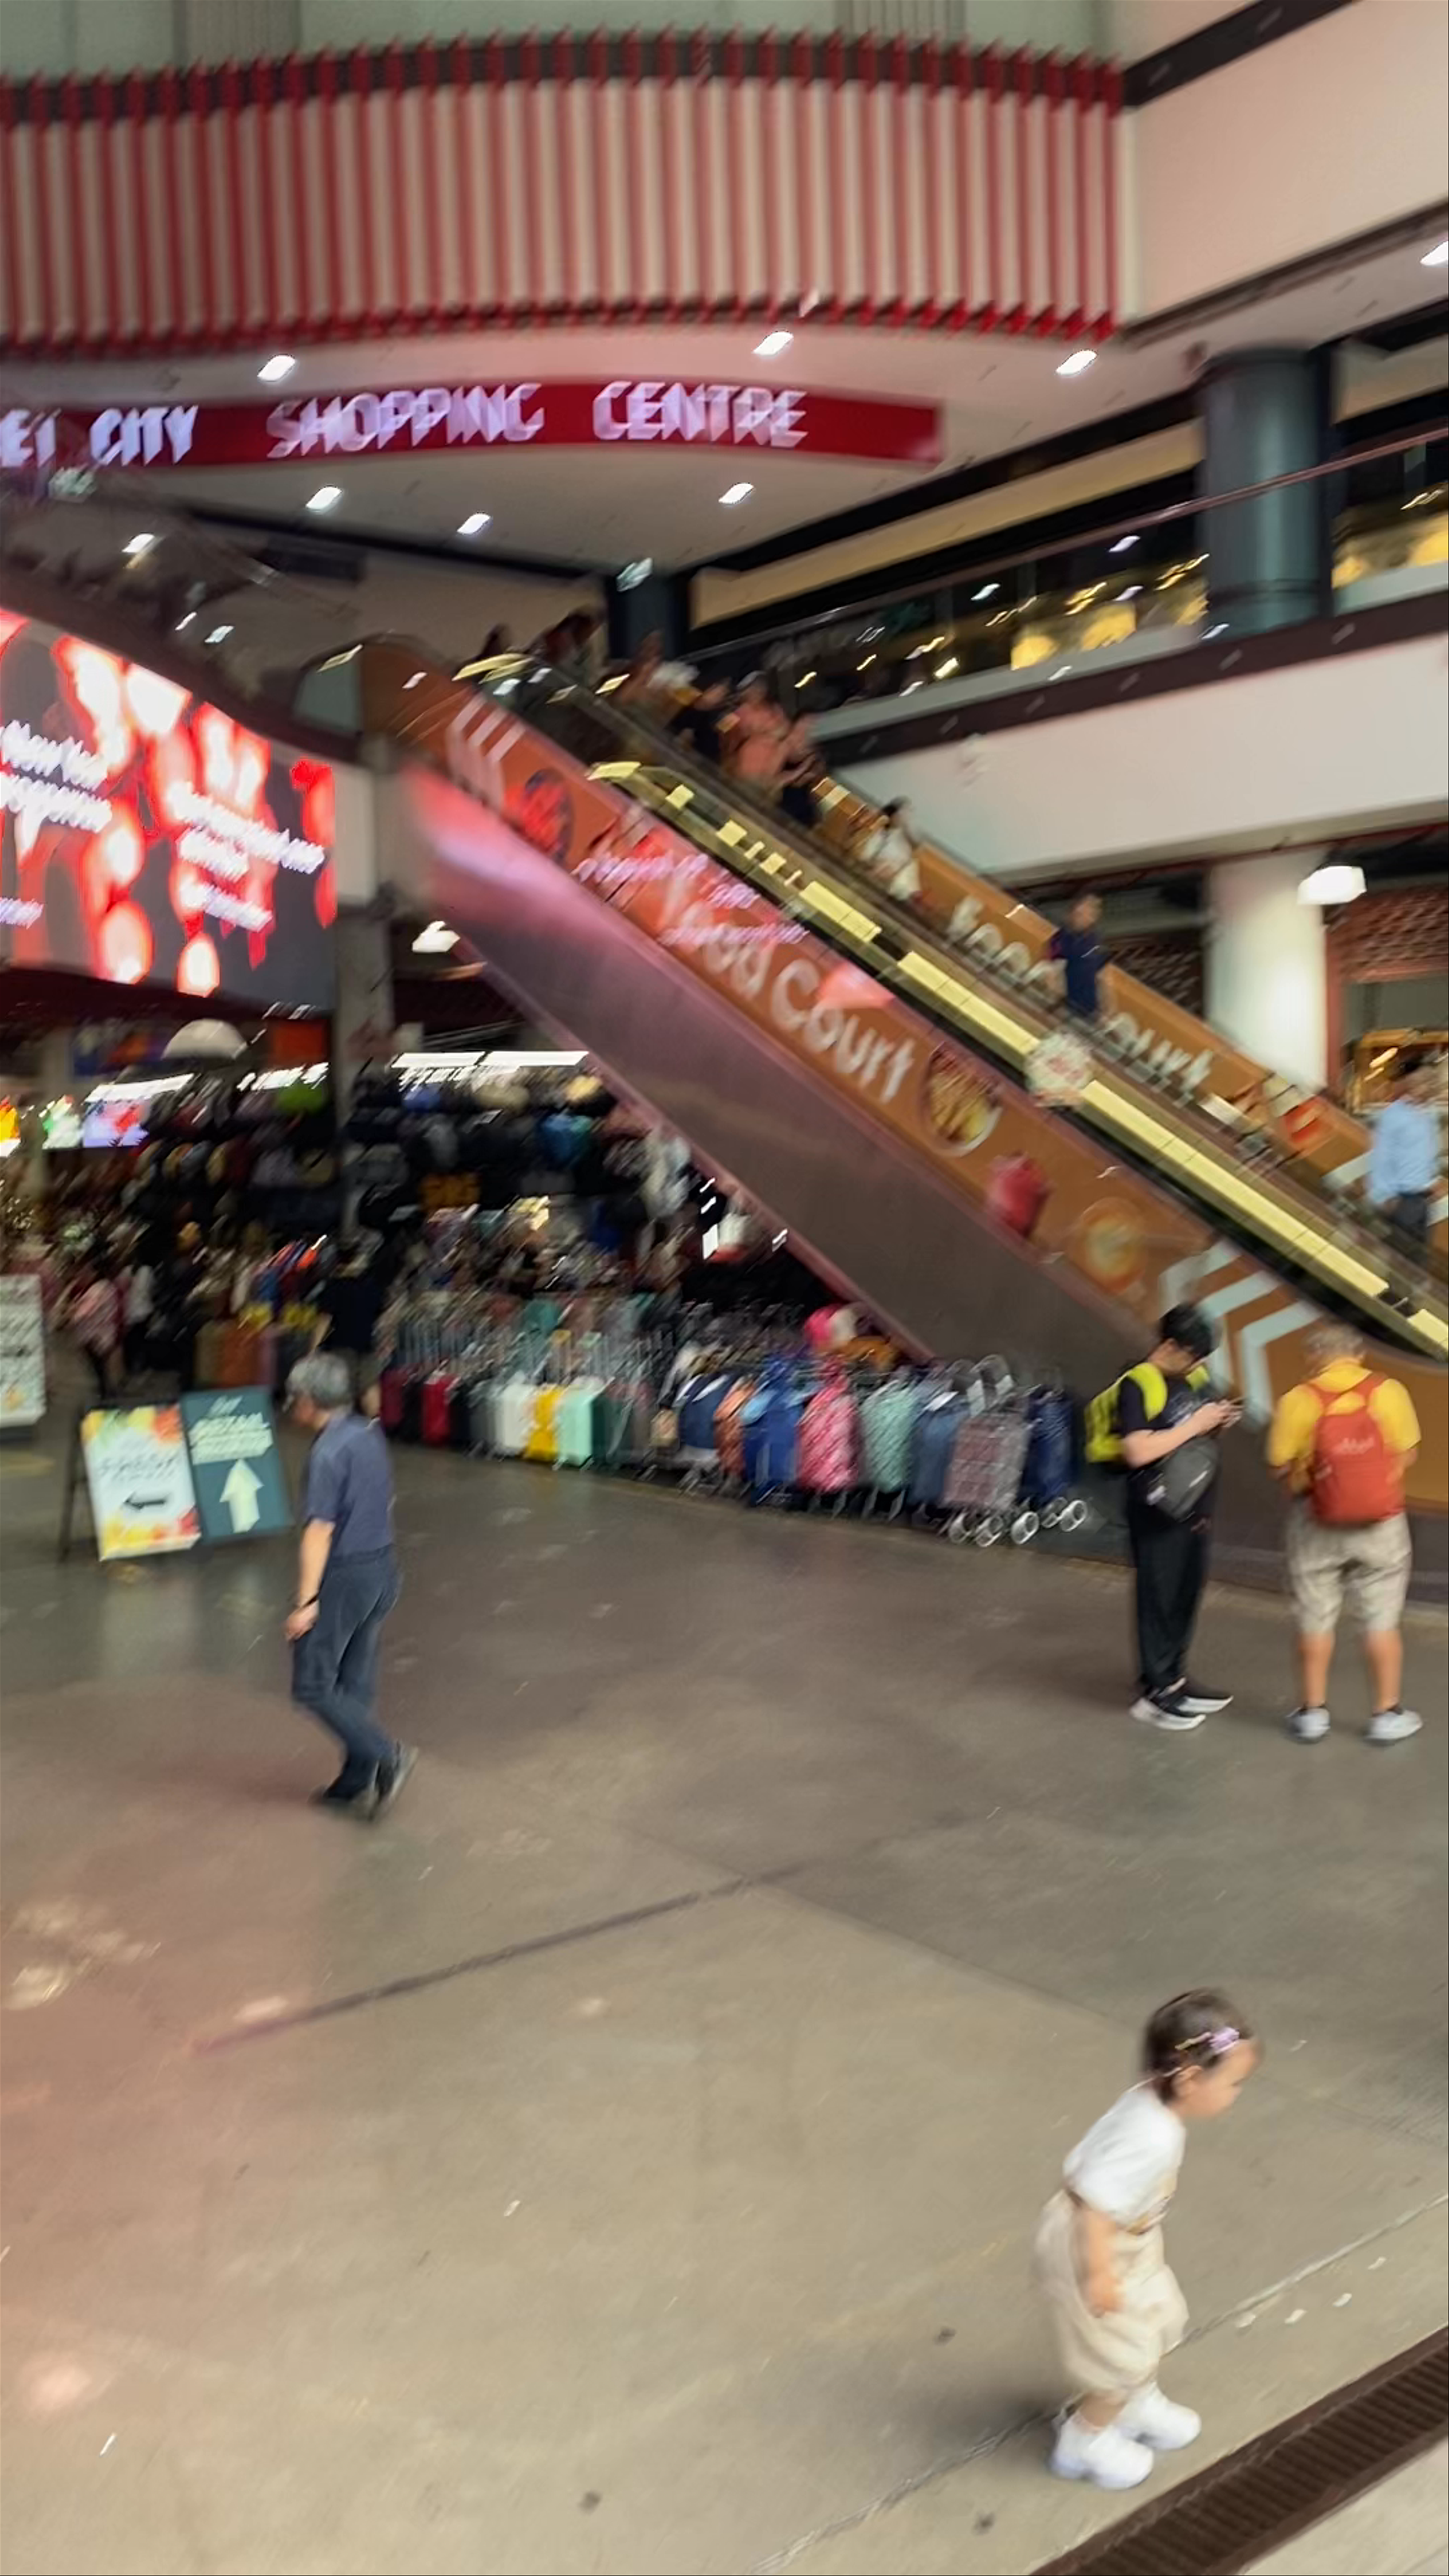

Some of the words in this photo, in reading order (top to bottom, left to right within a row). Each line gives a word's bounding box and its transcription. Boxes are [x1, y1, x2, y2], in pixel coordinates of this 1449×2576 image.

[89, 404, 199, 466] CITY
[265, 382, 546, 459] SHOPPING
[592, 381, 809, 448] CENTRE
[772, 958, 916, 1105] Court
